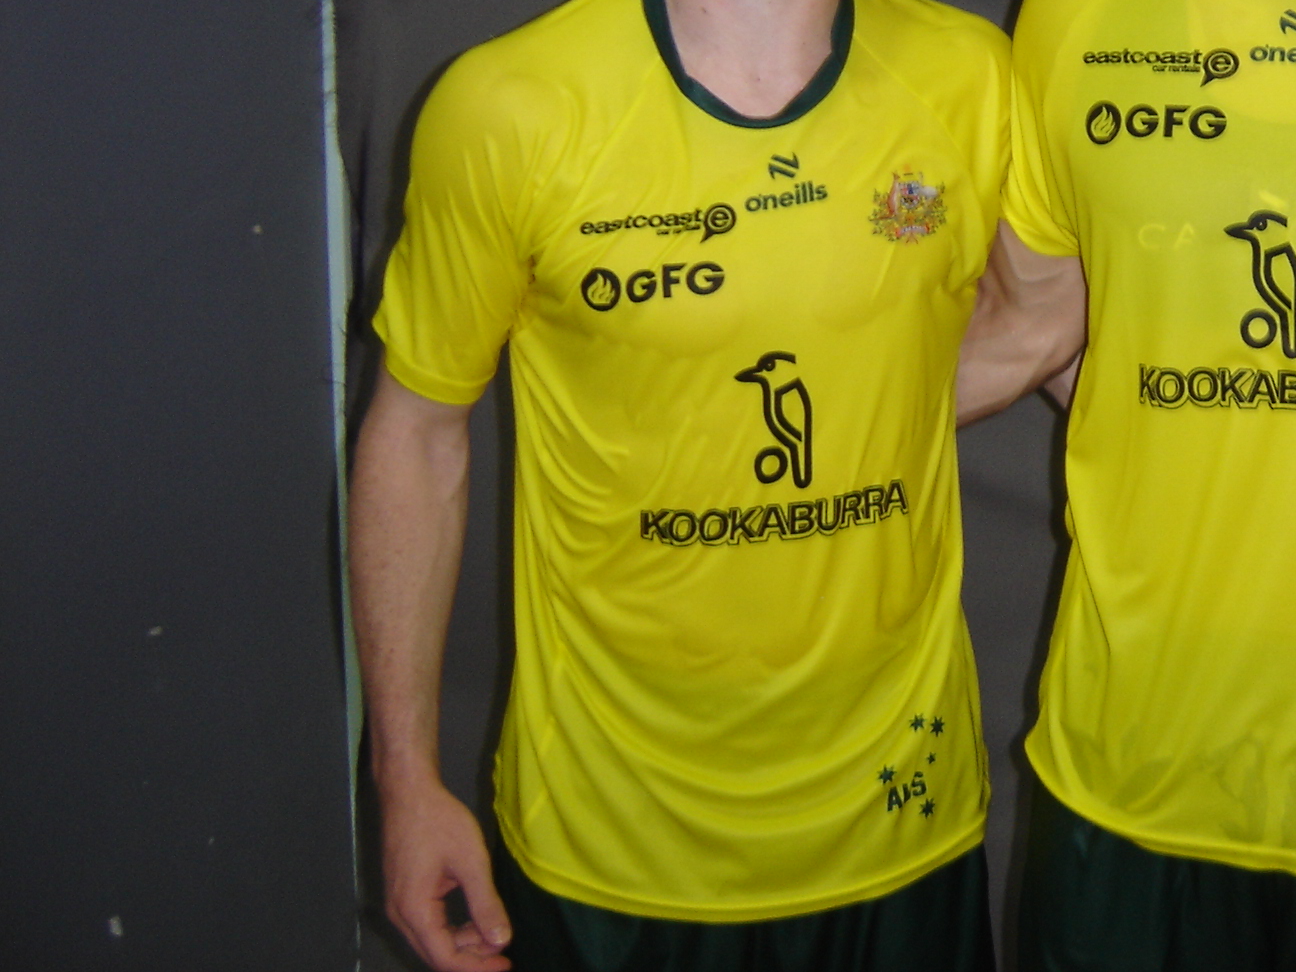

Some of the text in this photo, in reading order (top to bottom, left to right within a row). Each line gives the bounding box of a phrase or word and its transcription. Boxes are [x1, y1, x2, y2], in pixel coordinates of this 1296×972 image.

[1082, 48, 1203, 66] eastcoast
[1125, 103, 1228, 140] GFG
[580, 208, 704, 235] eastcoast
[626, 261, 725, 303] GFG
[640, 479, 909, 546] KOOKABURRA
